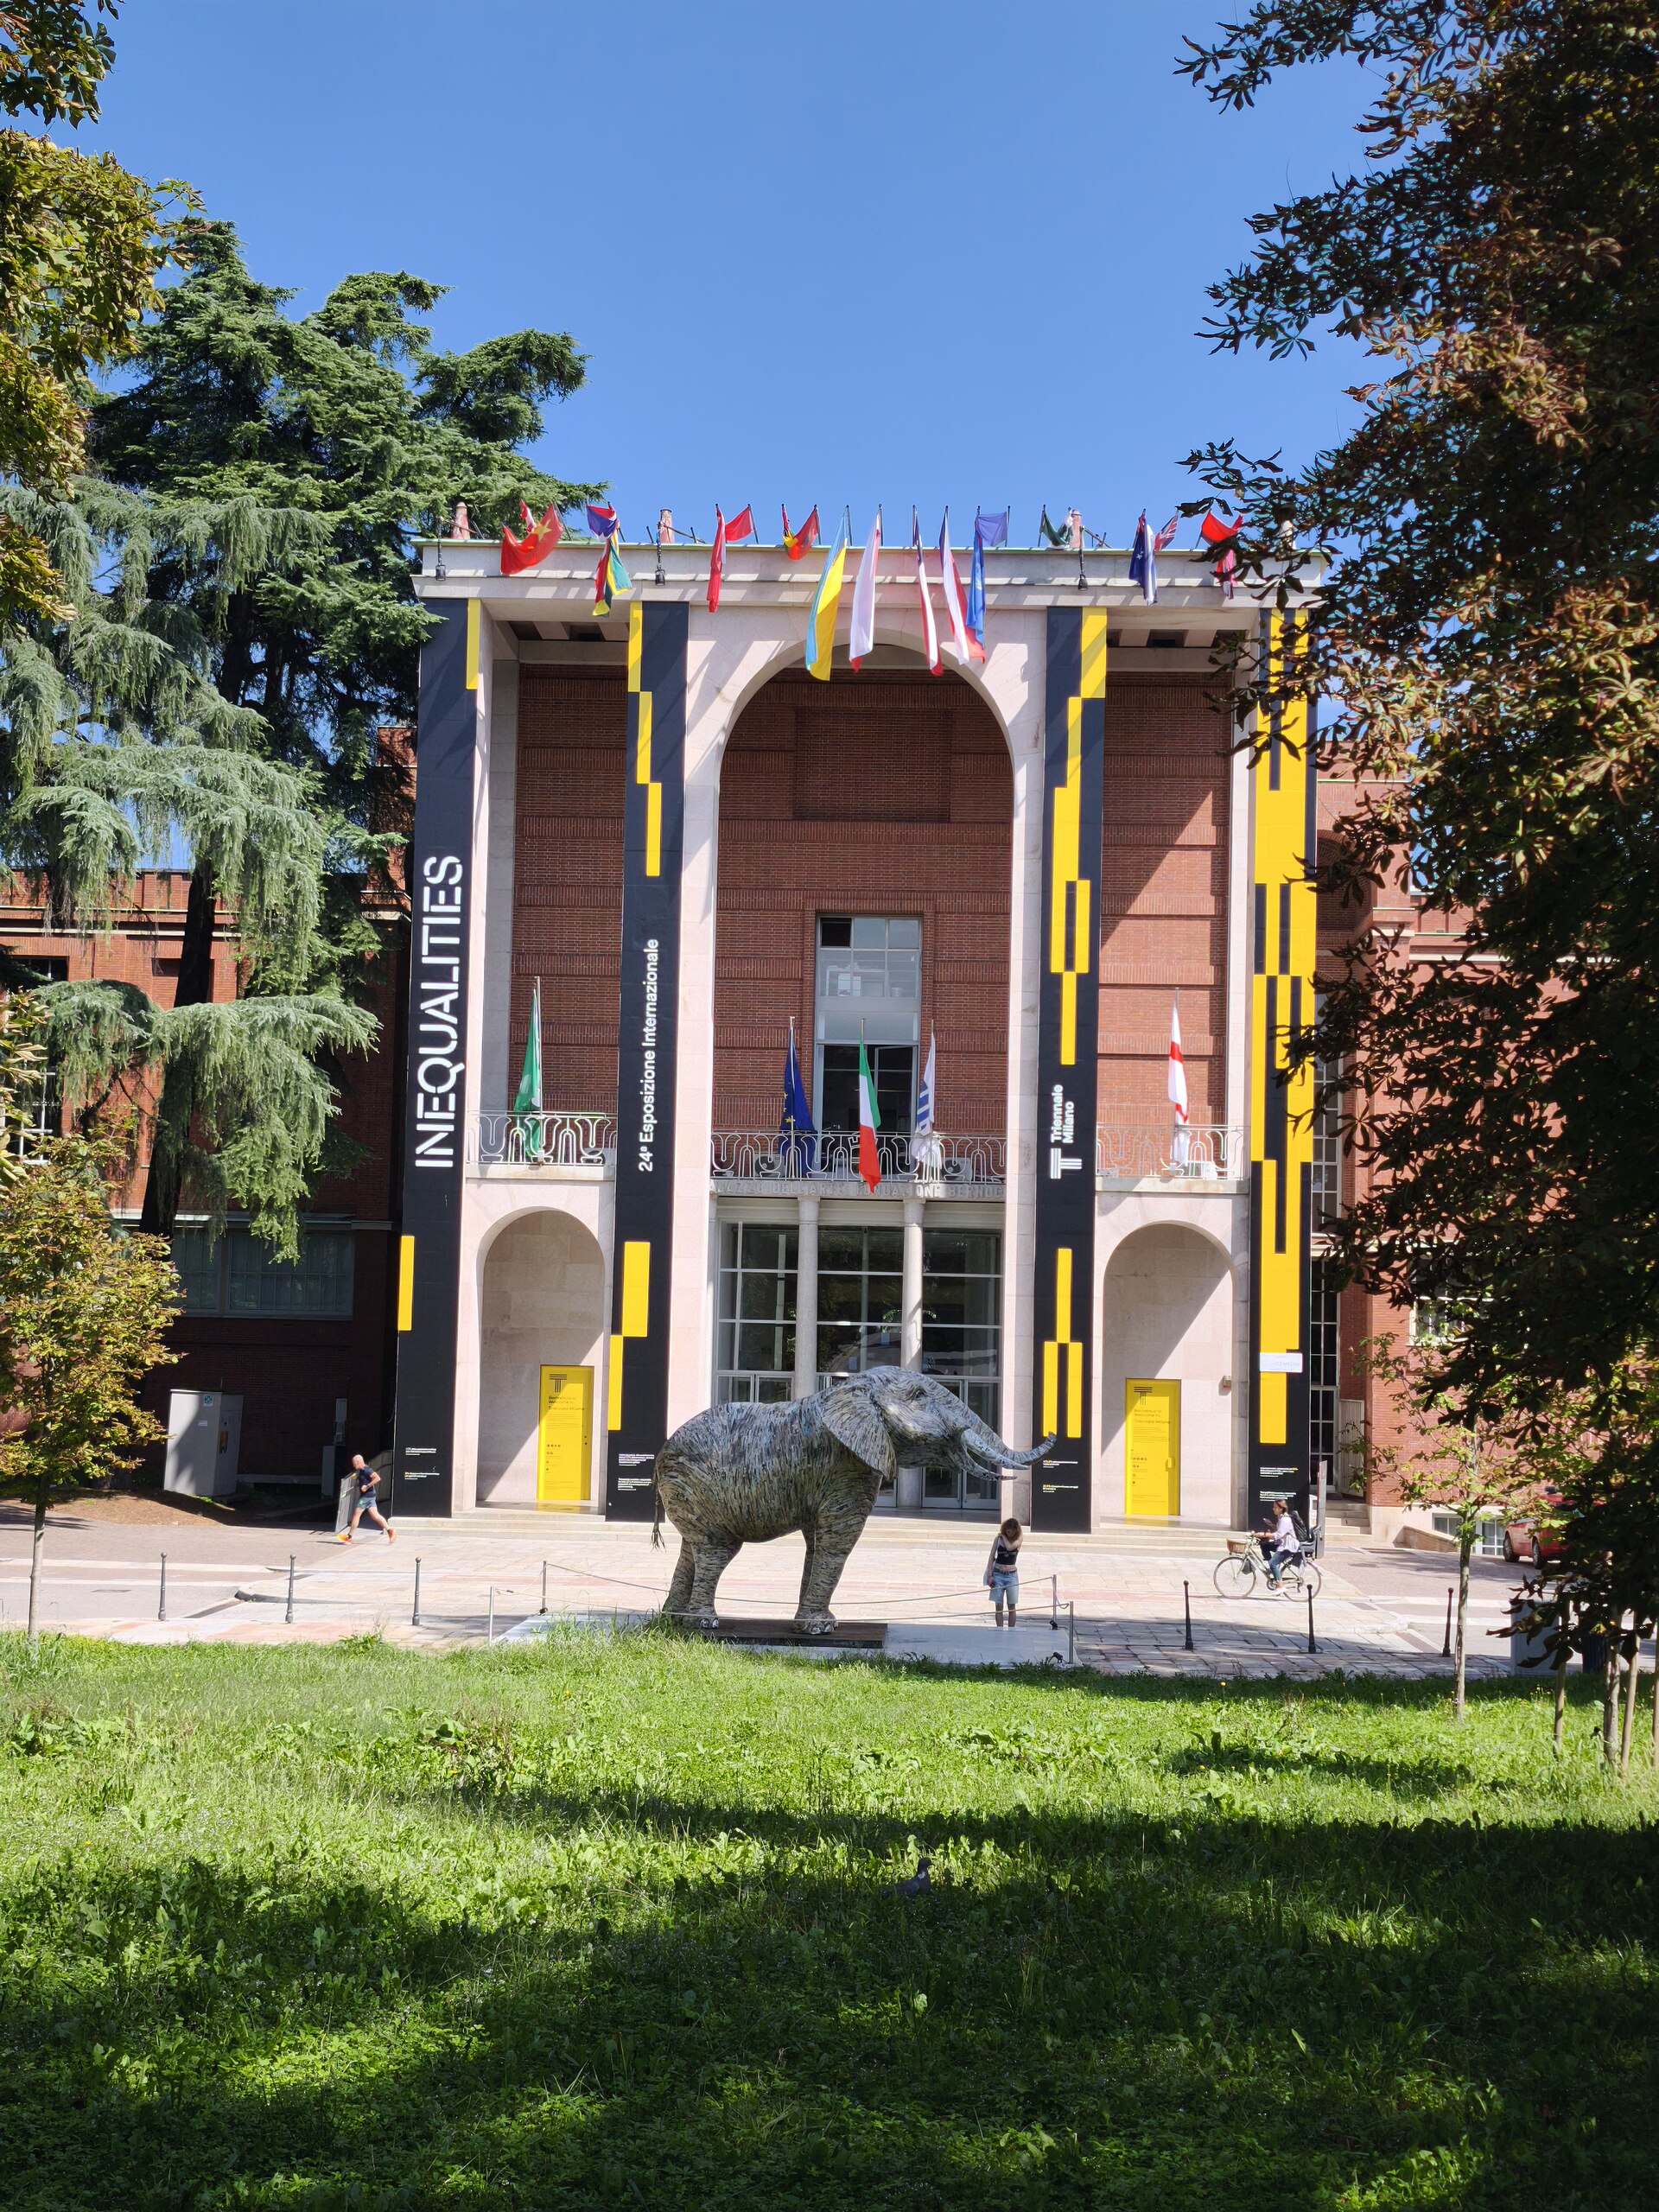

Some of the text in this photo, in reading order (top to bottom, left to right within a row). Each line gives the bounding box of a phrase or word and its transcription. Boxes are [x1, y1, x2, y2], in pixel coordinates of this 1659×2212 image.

[415, 855, 465, 1167] INEQUALITIES
[641, 939, 659, 1046] Internazionale
[639, 1050, 658, 1143] Esposizione
[1051, 1084, 1064, 1143] Triennale
[1062, 1101, 1075, 1143] Milano
